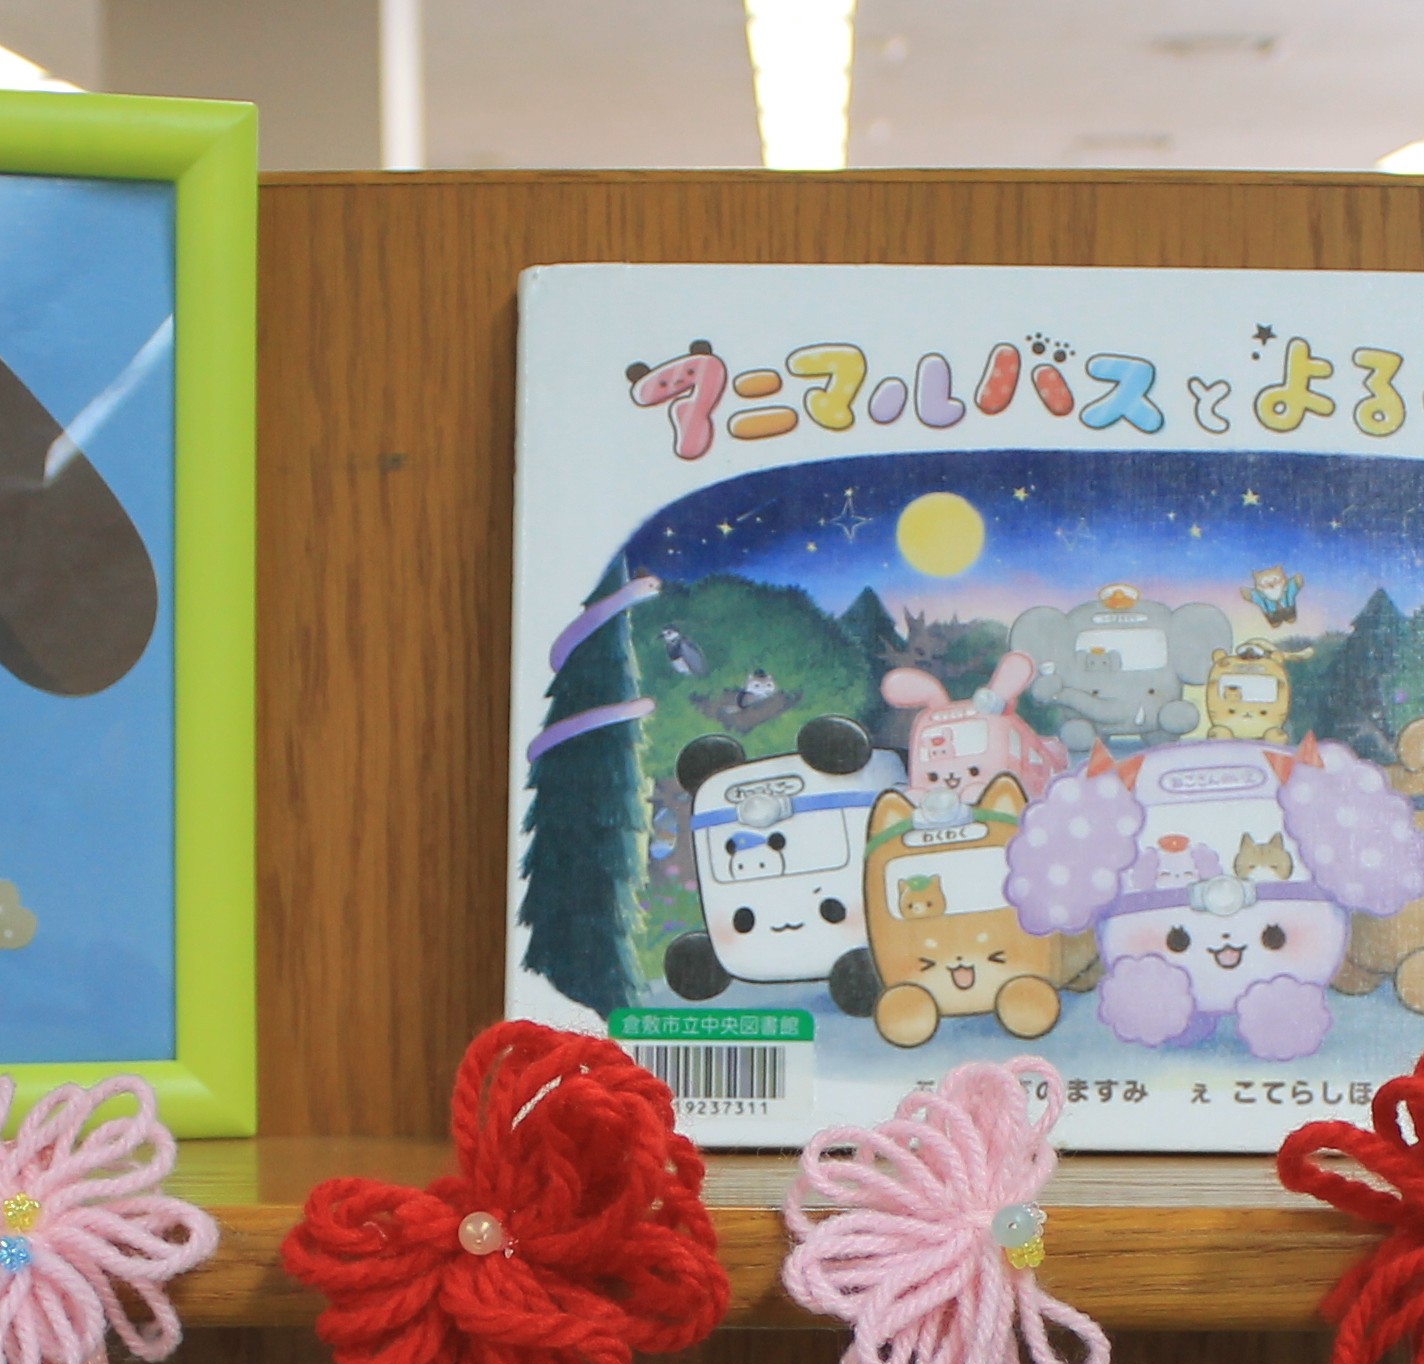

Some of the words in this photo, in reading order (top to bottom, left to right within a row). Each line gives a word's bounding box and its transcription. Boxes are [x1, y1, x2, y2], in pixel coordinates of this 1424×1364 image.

[620, 1014, 800, 1036] 倉敷市立中央図書館
[1232, 1078, 1373, 1106] こてらしほ
